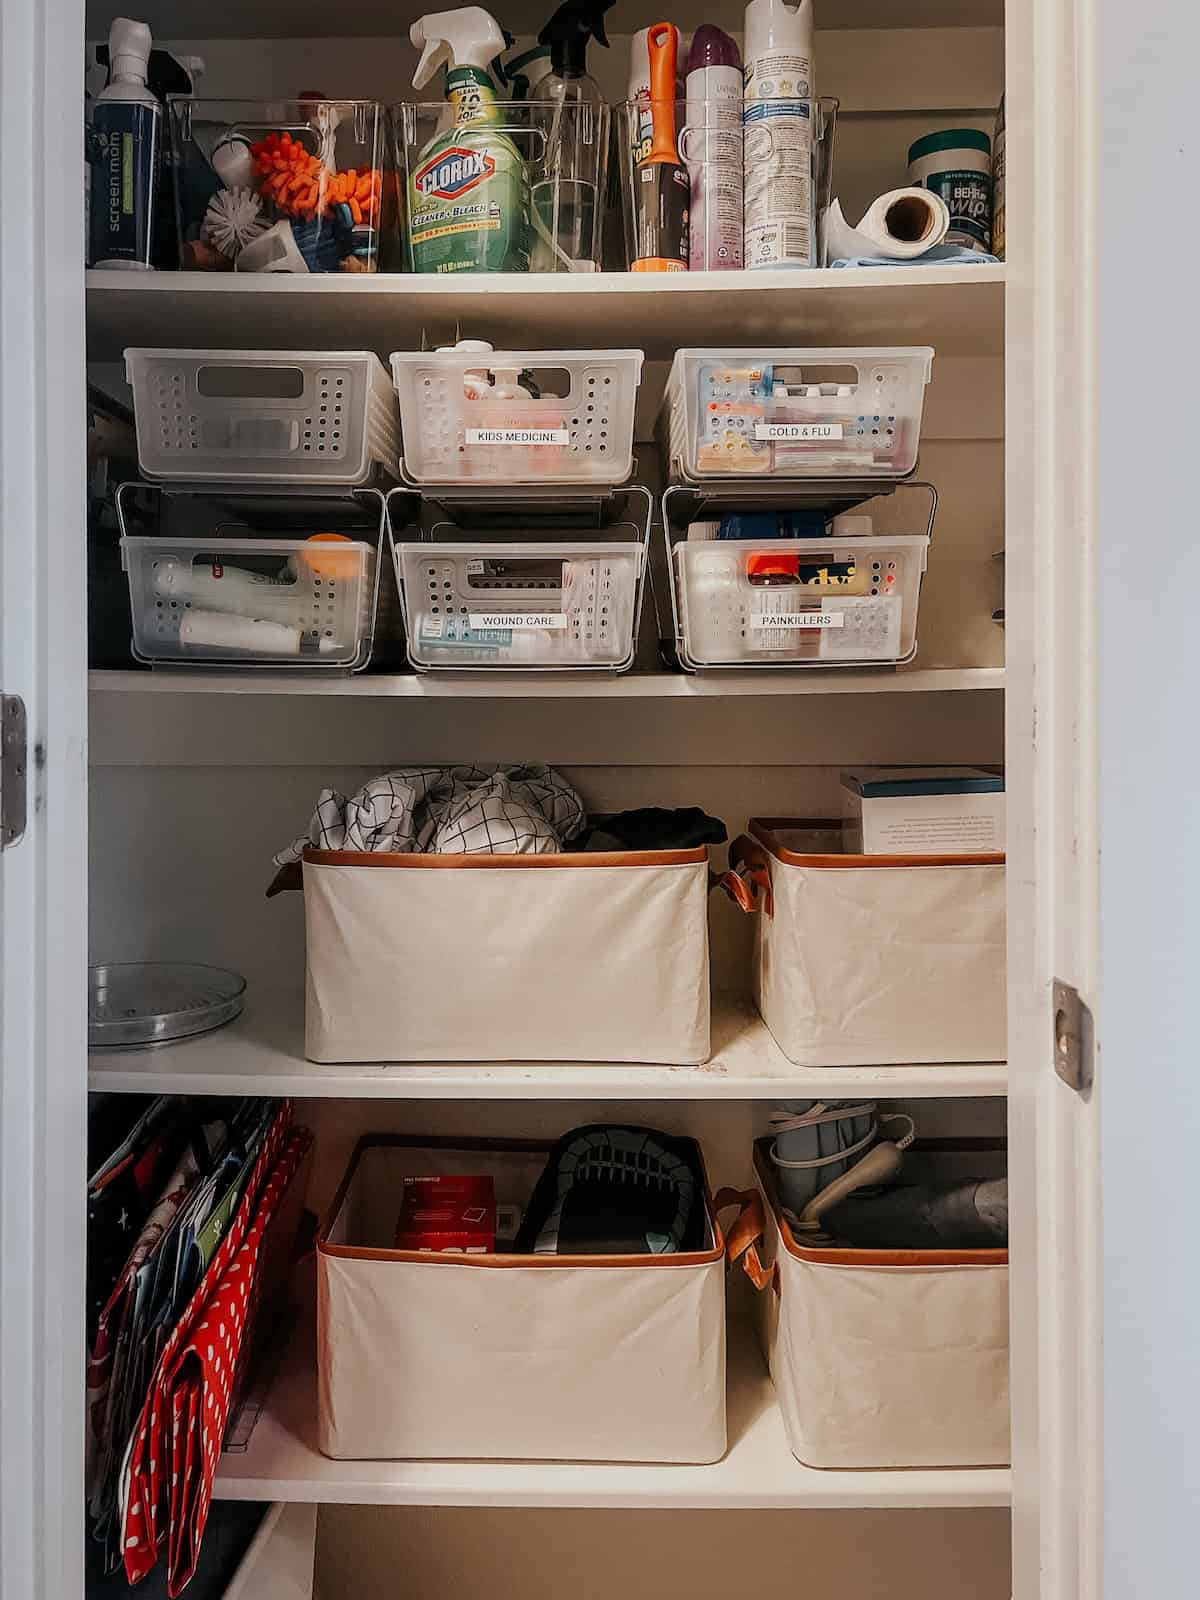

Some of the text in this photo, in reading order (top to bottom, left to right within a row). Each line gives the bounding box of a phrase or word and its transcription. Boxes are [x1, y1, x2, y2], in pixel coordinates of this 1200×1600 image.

[422, 148, 487, 197] CLOROX
[109, 131, 120, 232] screen mom
[954, 187, 981, 199] BEHR
[413, 211, 446, 227] CLEANER
[477, 432, 557, 442] KIDS MEDICINE
[768, 427, 831, 437] COLD & FLU
[482, 616, 555, 626] WOUND CARE
[762, 616, 832, 626] PAINKILLERS
